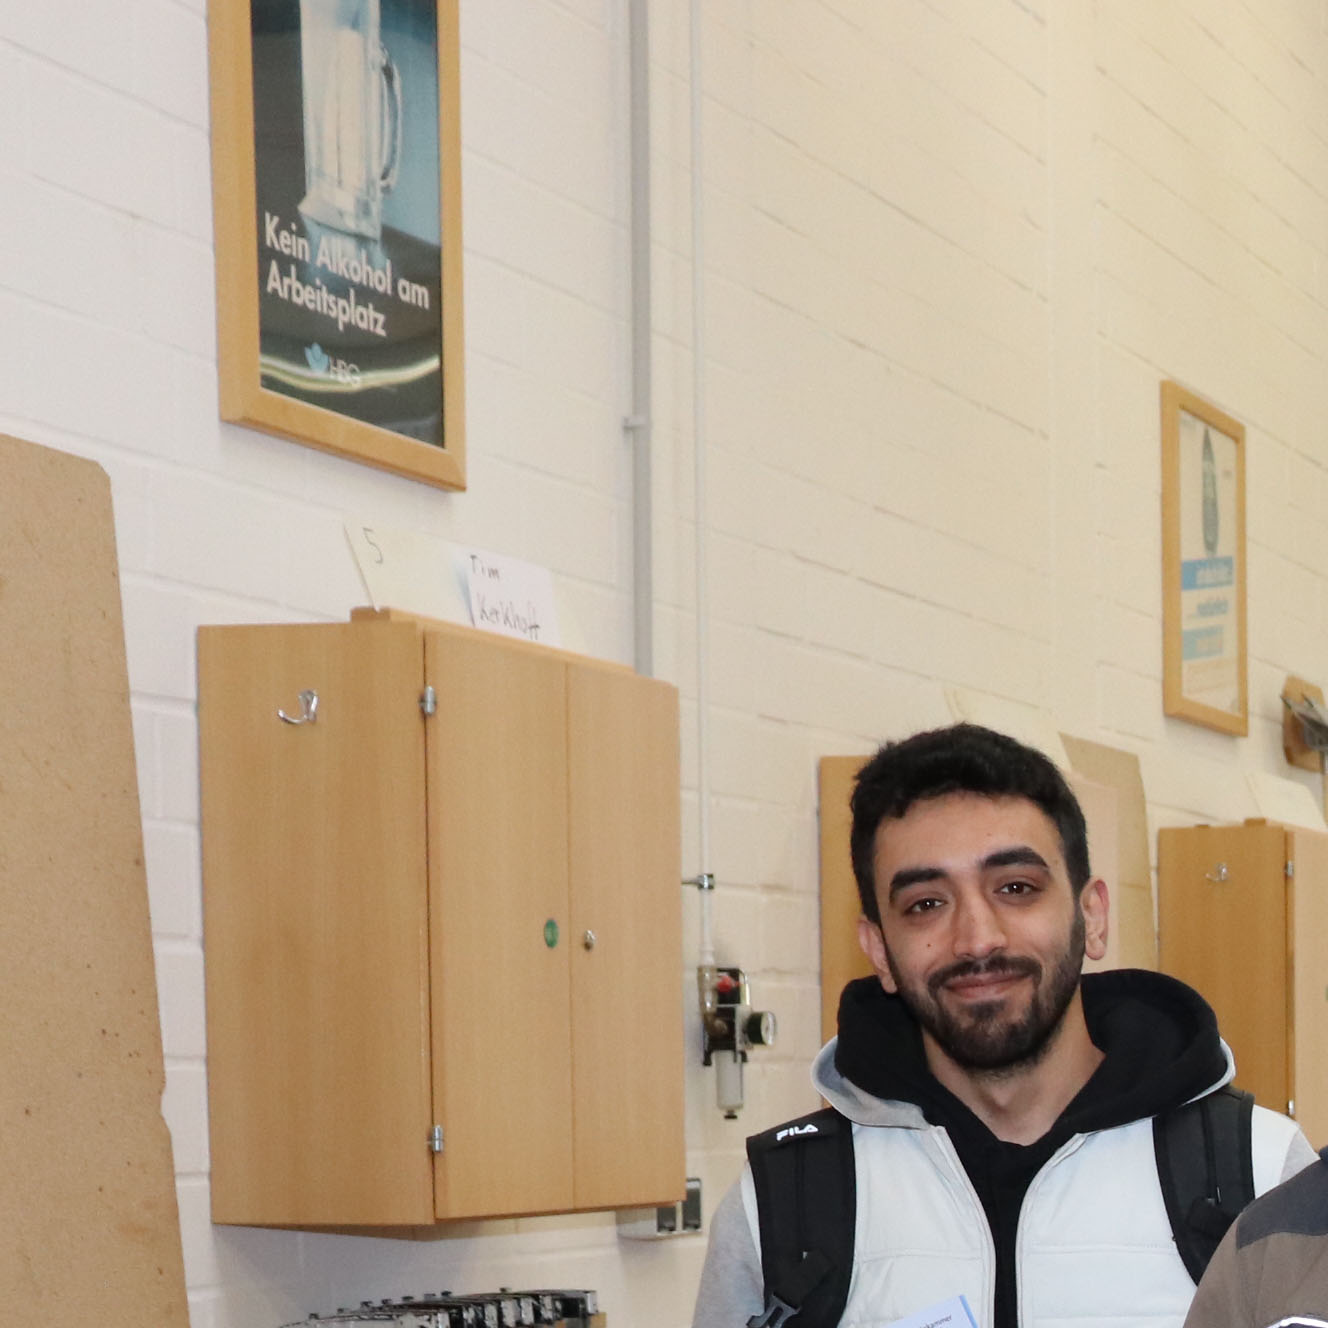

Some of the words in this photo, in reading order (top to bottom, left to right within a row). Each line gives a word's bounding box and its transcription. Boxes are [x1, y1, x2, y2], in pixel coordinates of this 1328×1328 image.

[264, 212, 310, 263] Kein
[317, 238, 393, 295] Alkohol
[398, 278, 430, 309] am
[266, 260, 387, 337] Arbeitsplatz
[776, 1123, 818, 1141] FILA
